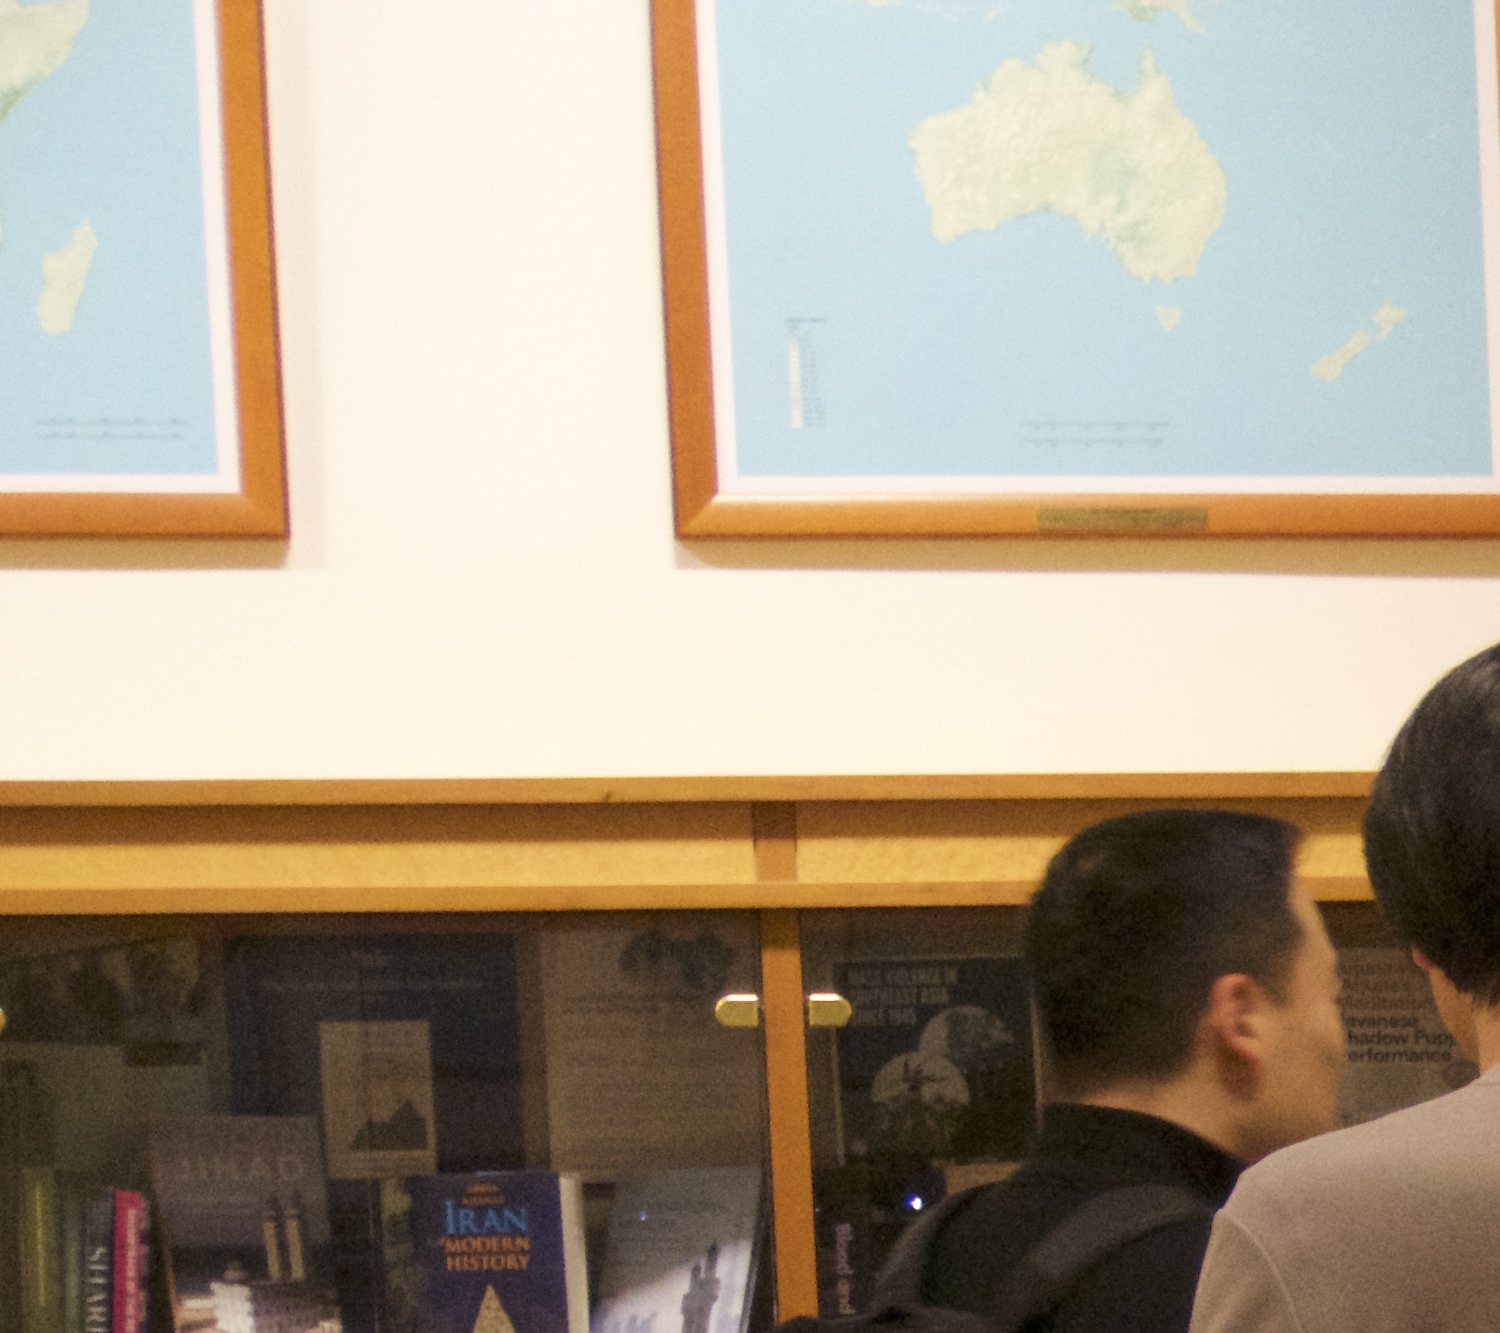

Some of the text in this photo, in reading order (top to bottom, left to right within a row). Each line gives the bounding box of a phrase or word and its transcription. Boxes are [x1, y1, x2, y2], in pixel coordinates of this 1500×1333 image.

[1347, 1030, 1408, 1046] hadow
[1347, 1048, 1453, 1063] erformance
[444, 1199, 529, 1234] IRAN
[445, 1235, 531, 1253] MODERN
[445, 1253, 531, 1272] HISTORY
